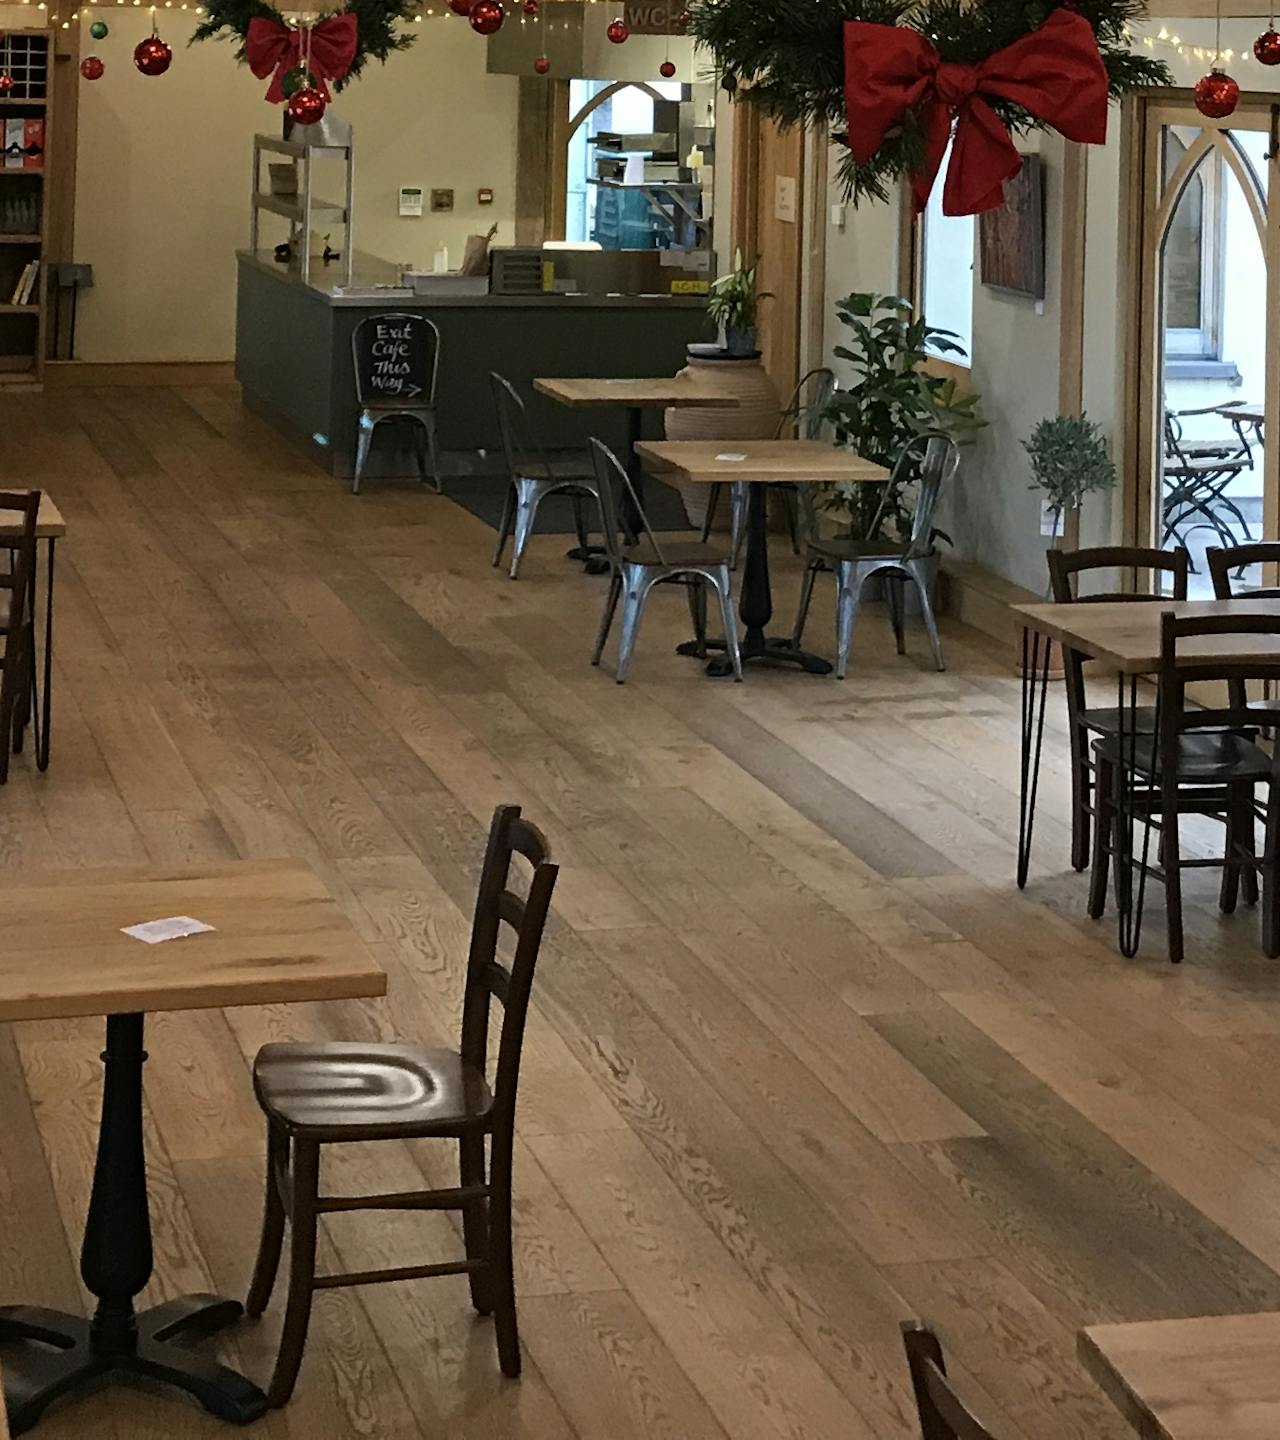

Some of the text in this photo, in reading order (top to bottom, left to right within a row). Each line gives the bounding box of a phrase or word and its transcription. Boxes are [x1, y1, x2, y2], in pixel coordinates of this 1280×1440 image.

[376, 323, 412, 339] Exit
[372, 341, 411, 361] Cafe
[374, 361, 410, 374] This
[371, 376, 404, 394] Way
